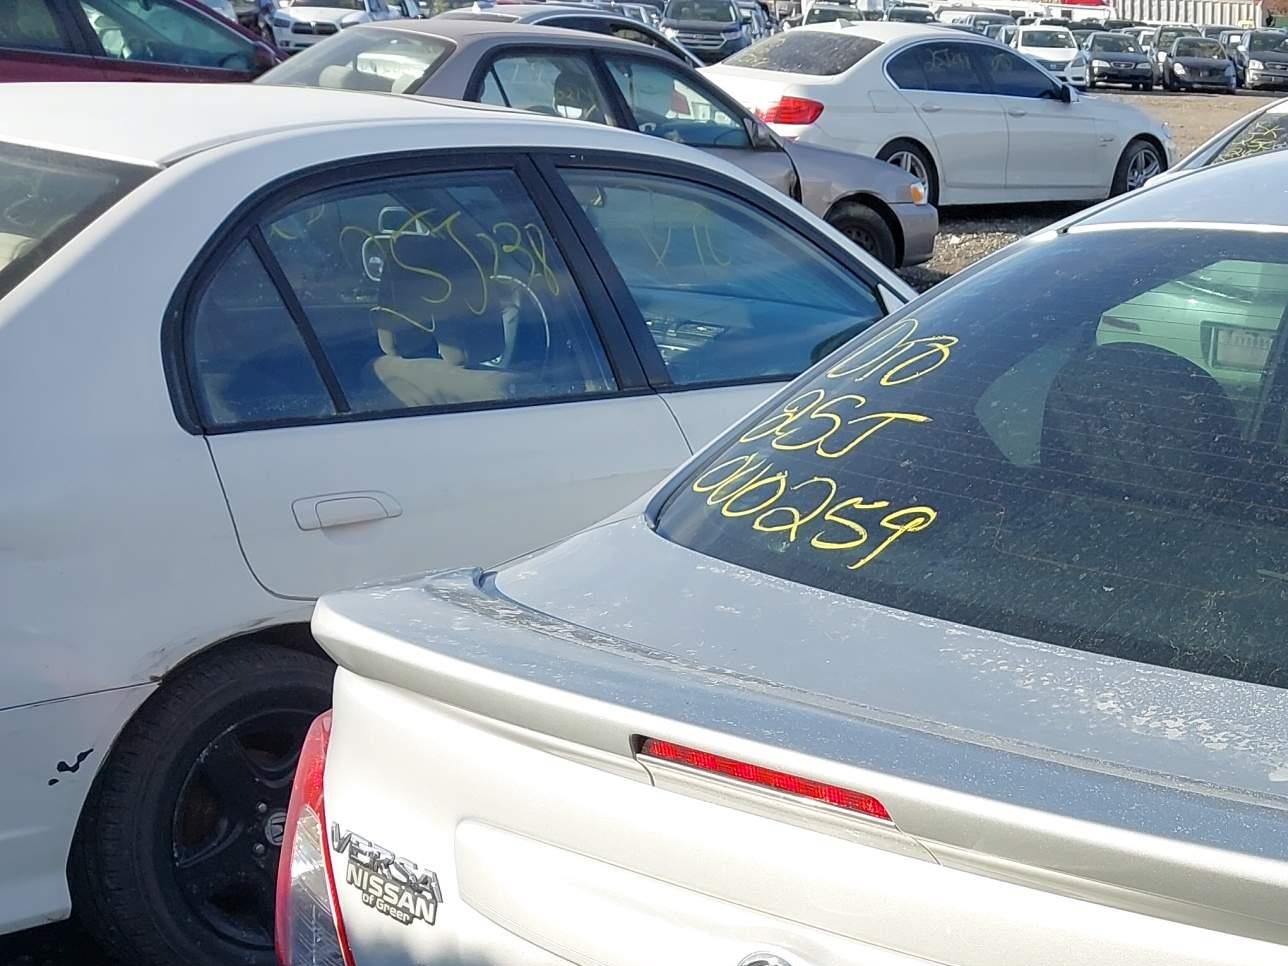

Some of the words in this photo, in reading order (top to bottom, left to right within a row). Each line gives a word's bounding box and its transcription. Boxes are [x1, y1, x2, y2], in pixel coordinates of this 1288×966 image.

[331, 821, 443, 904] VERSA
[346, 862, 437, 926] NISSAN
[362, 892, 376, 906] of
